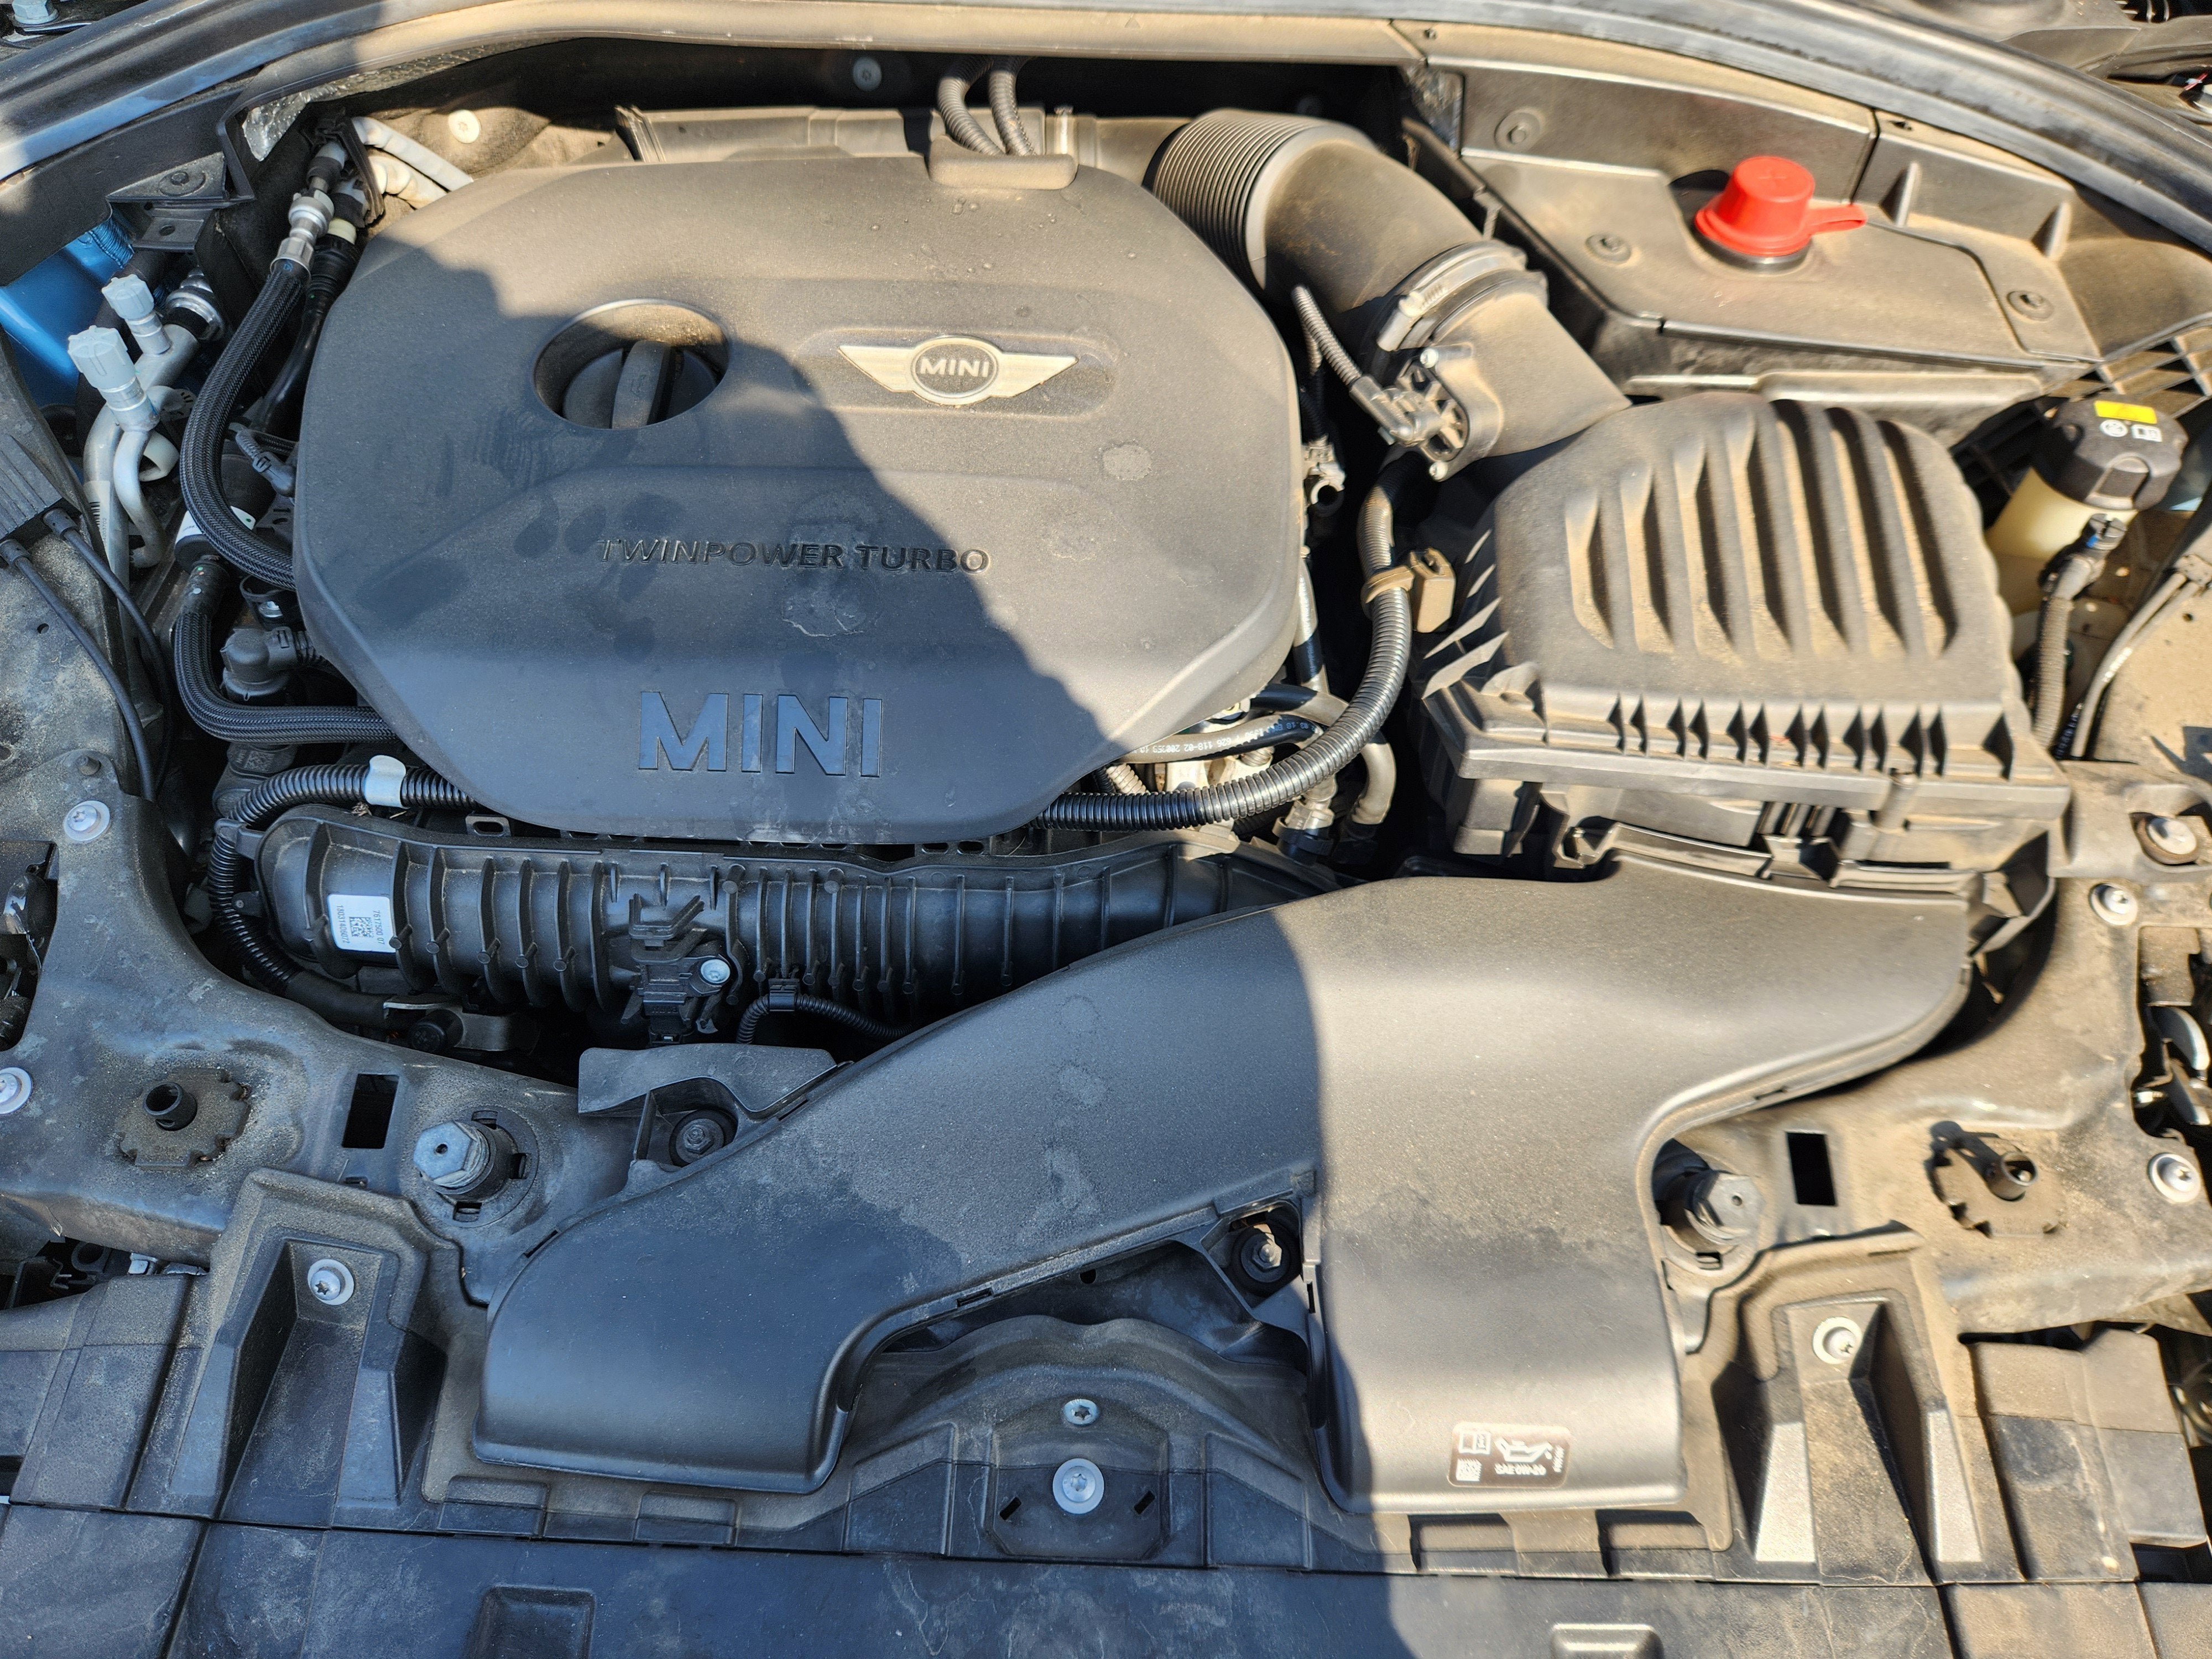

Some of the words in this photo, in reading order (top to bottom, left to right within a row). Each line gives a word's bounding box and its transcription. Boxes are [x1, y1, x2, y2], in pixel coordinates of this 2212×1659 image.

[920, 358, 989, 378] MINI
[597, 539, 846, 568] TWINPOWER
[857, 543, 991, 574] TURBO
[639, 691, 883, 778] MINI
[373, 910, 383, 936] 7617500
[377, 937, 385, 945] 07
